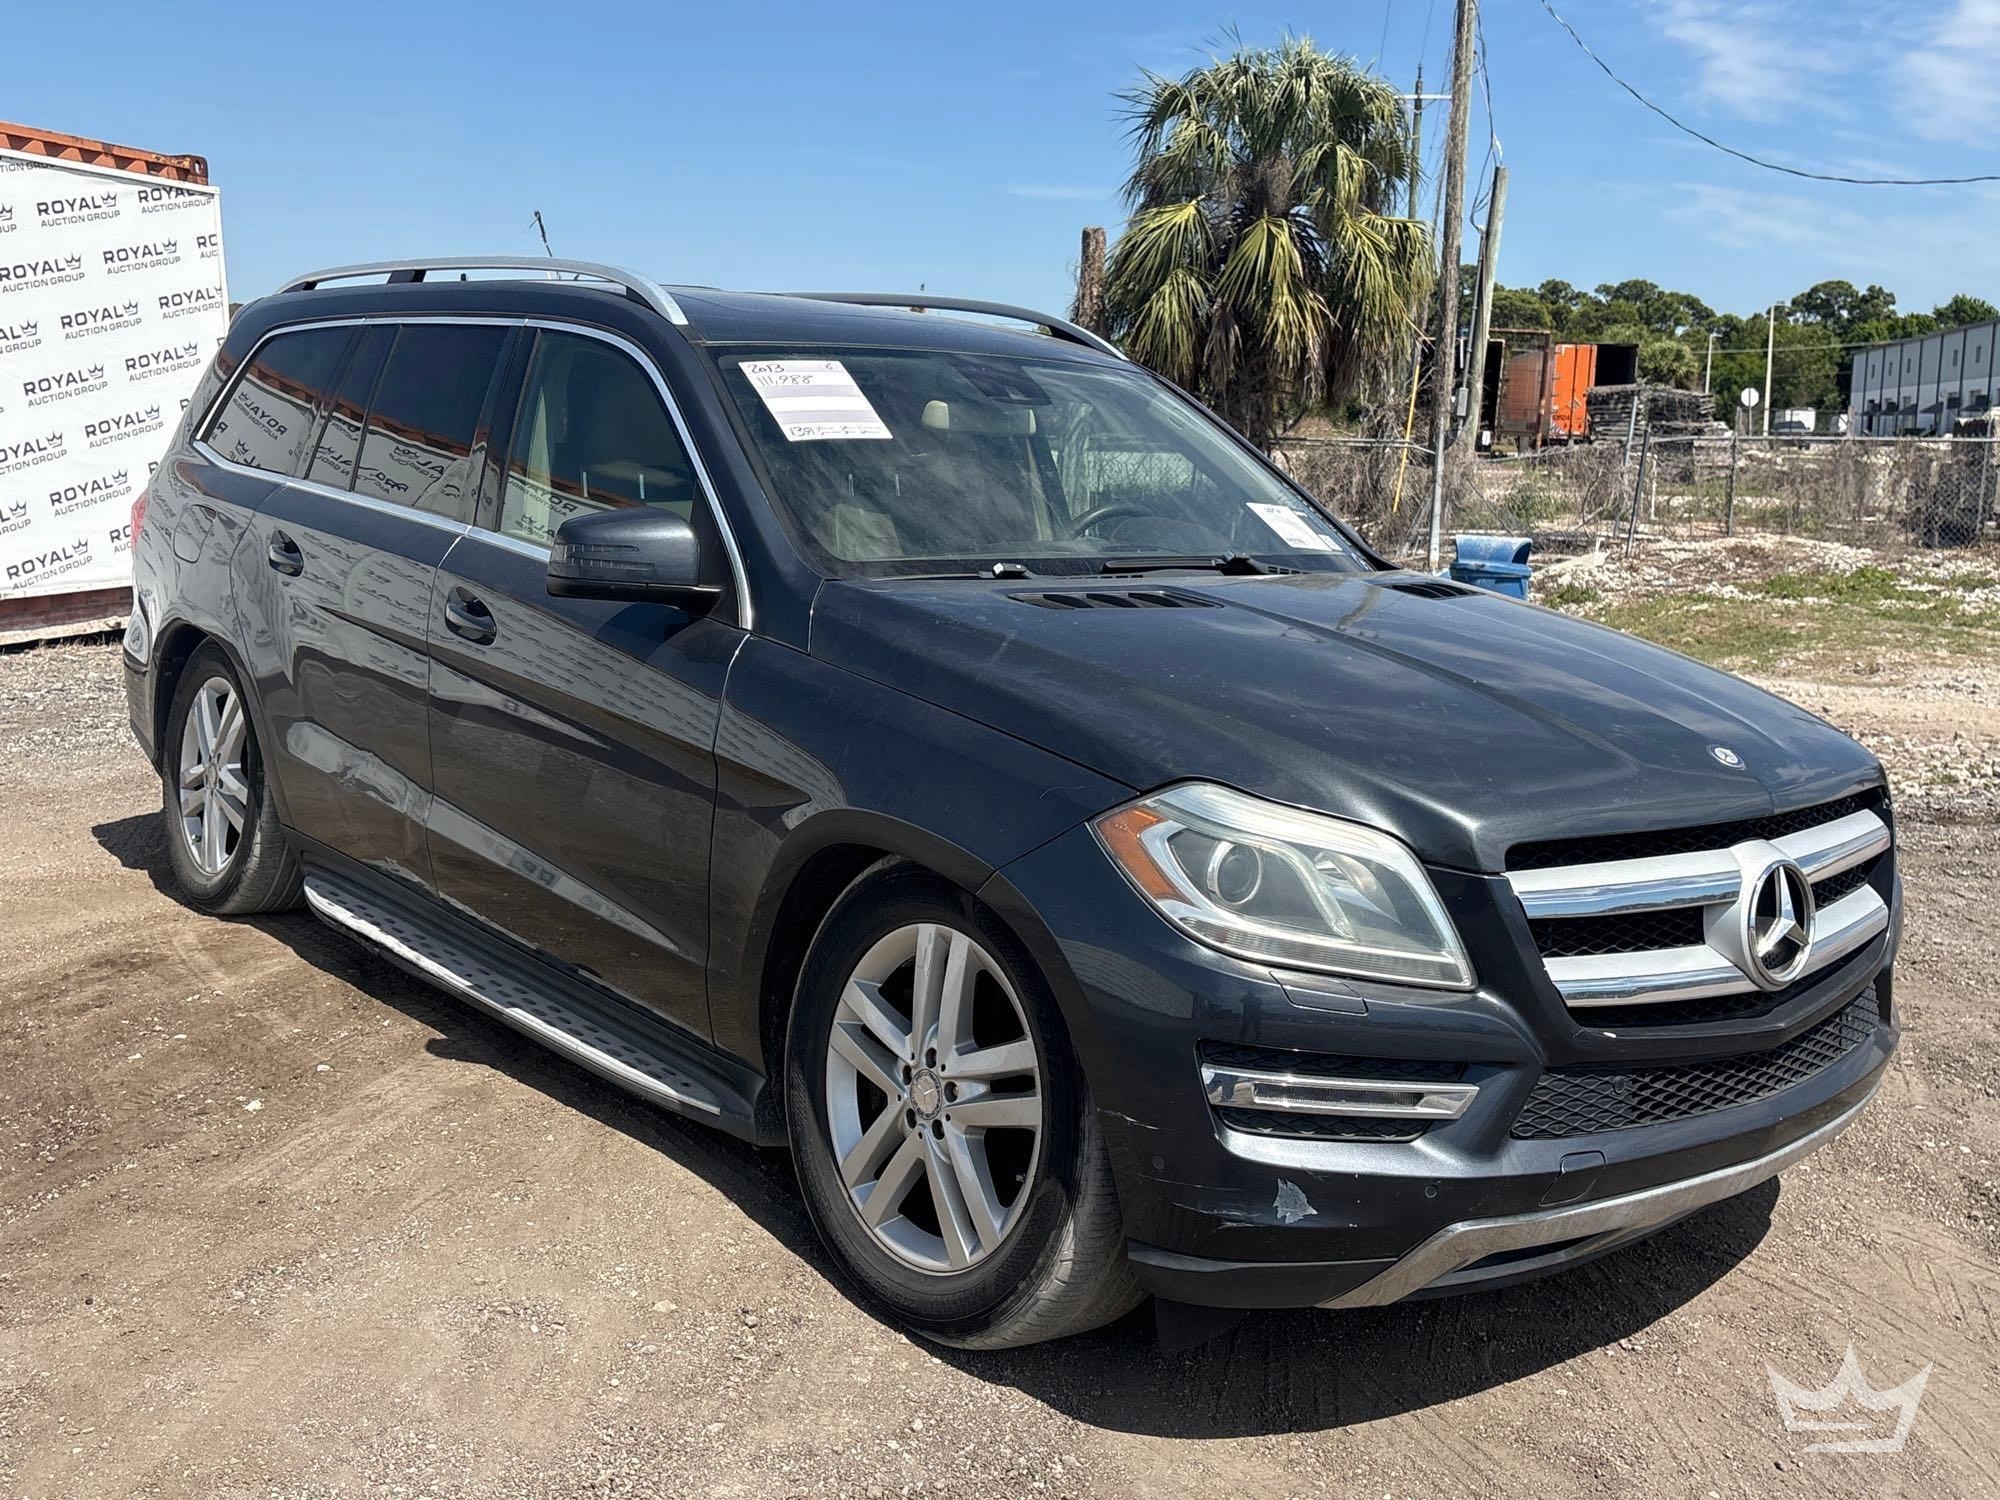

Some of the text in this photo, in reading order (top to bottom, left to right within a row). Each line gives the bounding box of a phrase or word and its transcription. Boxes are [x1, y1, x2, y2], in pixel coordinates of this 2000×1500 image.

[0, 162, 24, 173] TION
[36, 196, 102, 216] ROYAL
[141, 197, 212, 214] AUCTION GROUP
[41, 209, 120, 228] AUCTION GROUP
[103, 243, 163, 264] ROYAL
[0, 259, 65, 281] ROYAL
[107, 256, 181, 275] AUCTION GROUP
[2, 272, 85, 293] AUCTION GROUP
[158, 288, 216, 309] ROYAL
[60, 306, 124, 329] ROYAL
[162, 301, 223, 320] AUCTION GRO
[64, 317, 142, 341] AUCTION GROUP
[5, 338, 42, 353] GROUP
[125, 347, 184, 371] ROYAL
[129, 358, 201, 382] AUCTION GROUP
[748, 363, 784, 373] 2013
[23, 369, 89, 396] ROYAL
[28, 381, 108, 407] AUCTION GROUP
[85, 411, 146, 438] ROYAL
[89, 421, 164, 449] AUCTION GROUP
[0, 439, 47, 463] OYAL
[0, 449, 67, 475] CTION GROUP
[49, 477, 113, 507] ROYAL
[54, 486, 132, 518] AUCTION GROUP
[0, 518, 31, 536] ROUP
[6, 547, 74, 580] ROYAL
[12, 555, 93, 591] AUCTION GROUP
